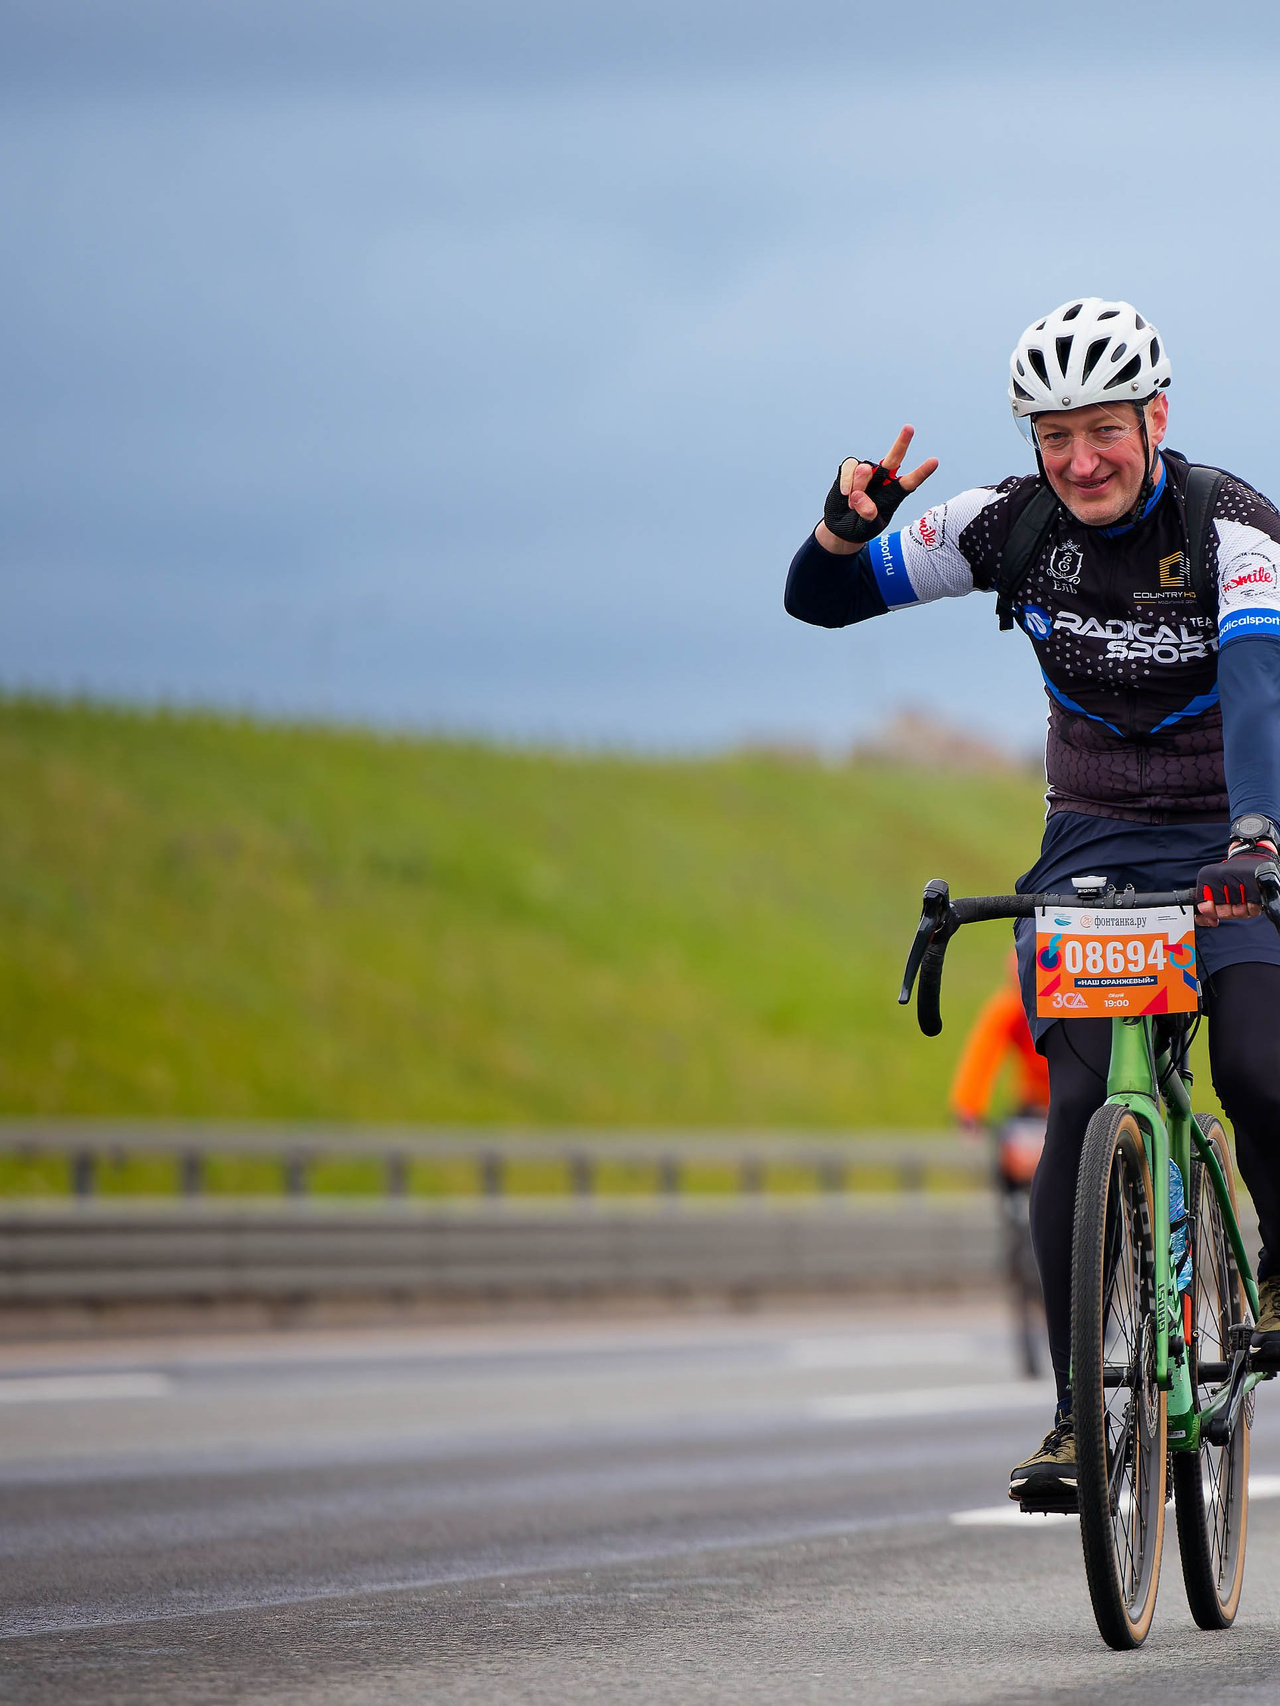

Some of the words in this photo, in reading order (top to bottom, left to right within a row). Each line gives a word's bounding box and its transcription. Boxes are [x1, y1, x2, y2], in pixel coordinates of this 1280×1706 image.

[1052, 609, 1205, 644] RADICAL
[1104, 640, 1219, 664] SPORT
[1094, 915, 1147, 929] фонтанка.ру
[1065, 939, 1168, 974] 08694
[1077, 977, 1100, 986] «НАШ
[1101, 976, 1155, 986] ОРАНЖЕВЫЙ»
[1104, 999, 1129, 1008] 19:00
[1157, 1282, 1167, 1335] GHOST
